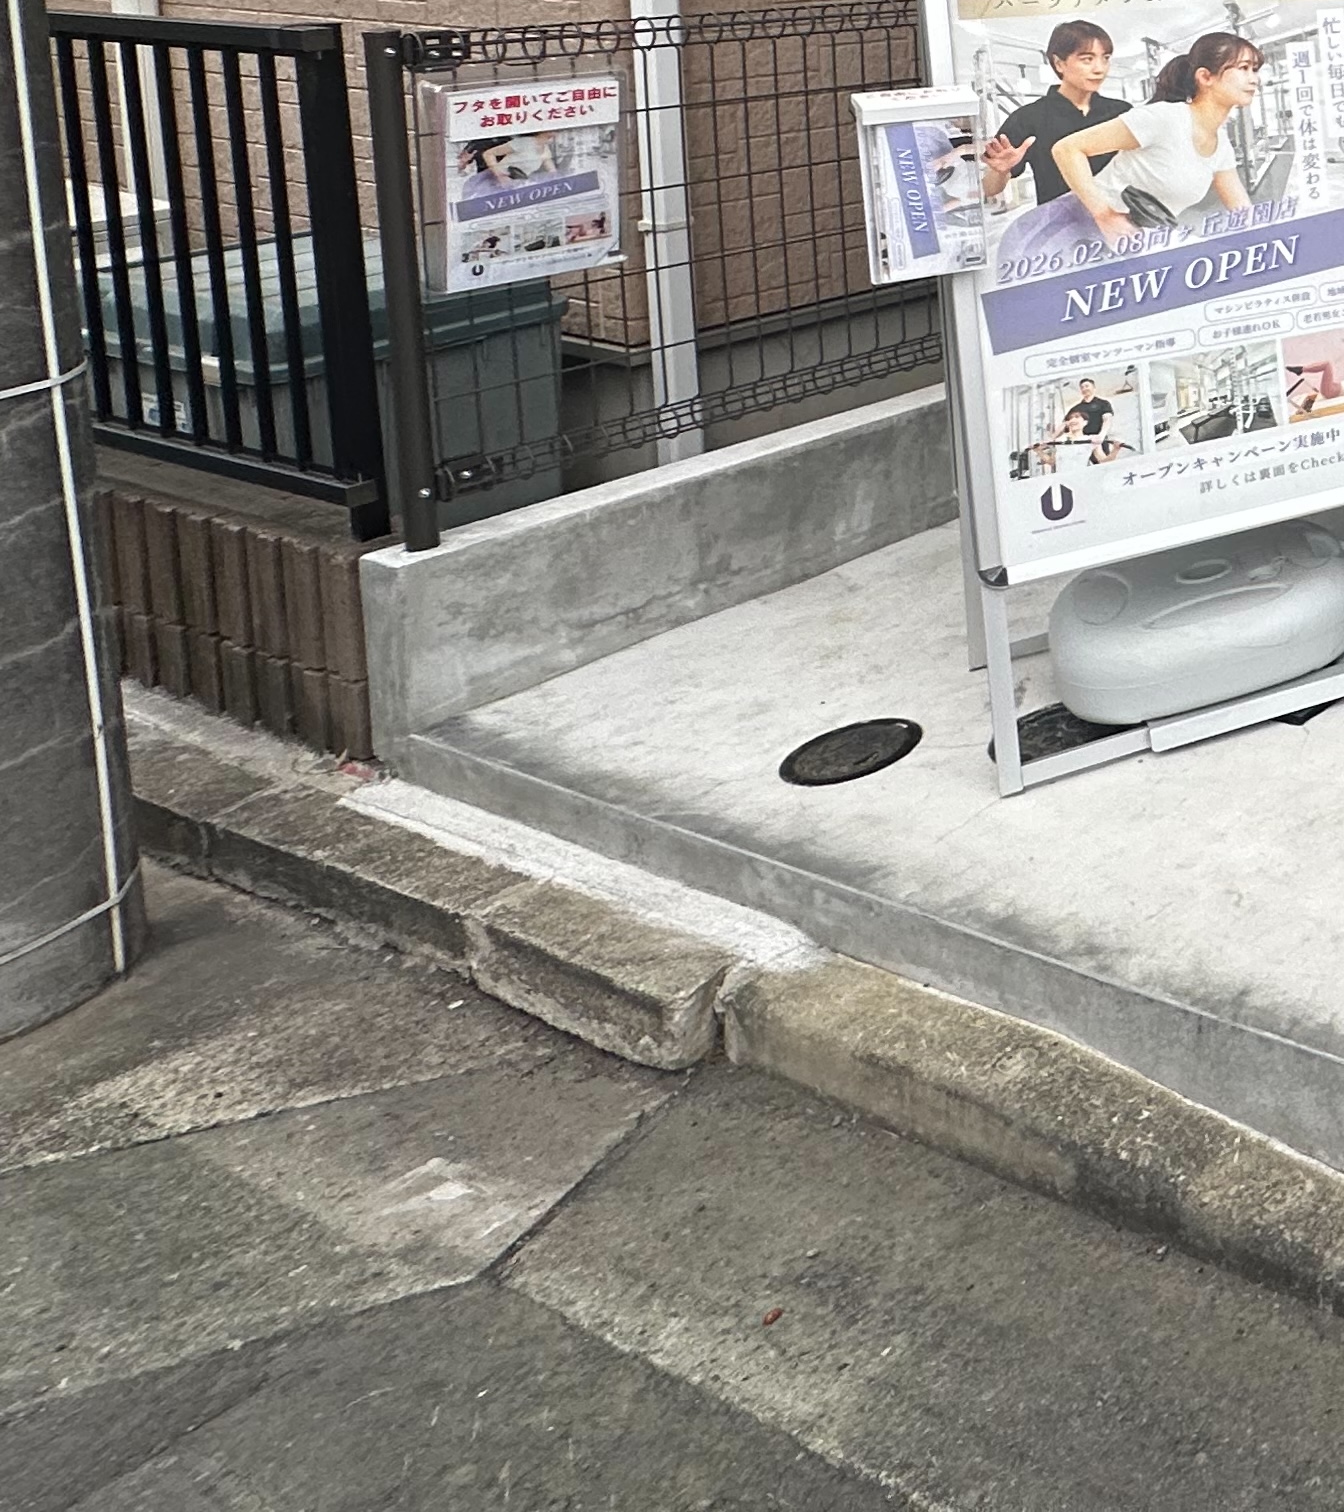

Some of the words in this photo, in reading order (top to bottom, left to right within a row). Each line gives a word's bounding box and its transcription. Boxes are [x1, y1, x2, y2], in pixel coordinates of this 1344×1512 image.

[453, 86, 618, 114] フタを開いてご自由に
[480, 104, 595, 128] お取りください
[1292, 51, 1322, 200] 週1回で体は変わる
[484, 191, 522, 211] NEW
[529, 181, 574, 201] OPEN
[906, 189, 930, 234] OPEN
[1060, 265, 1173, 322] NEW
[1184, 234, 1301, 290] OPEN
